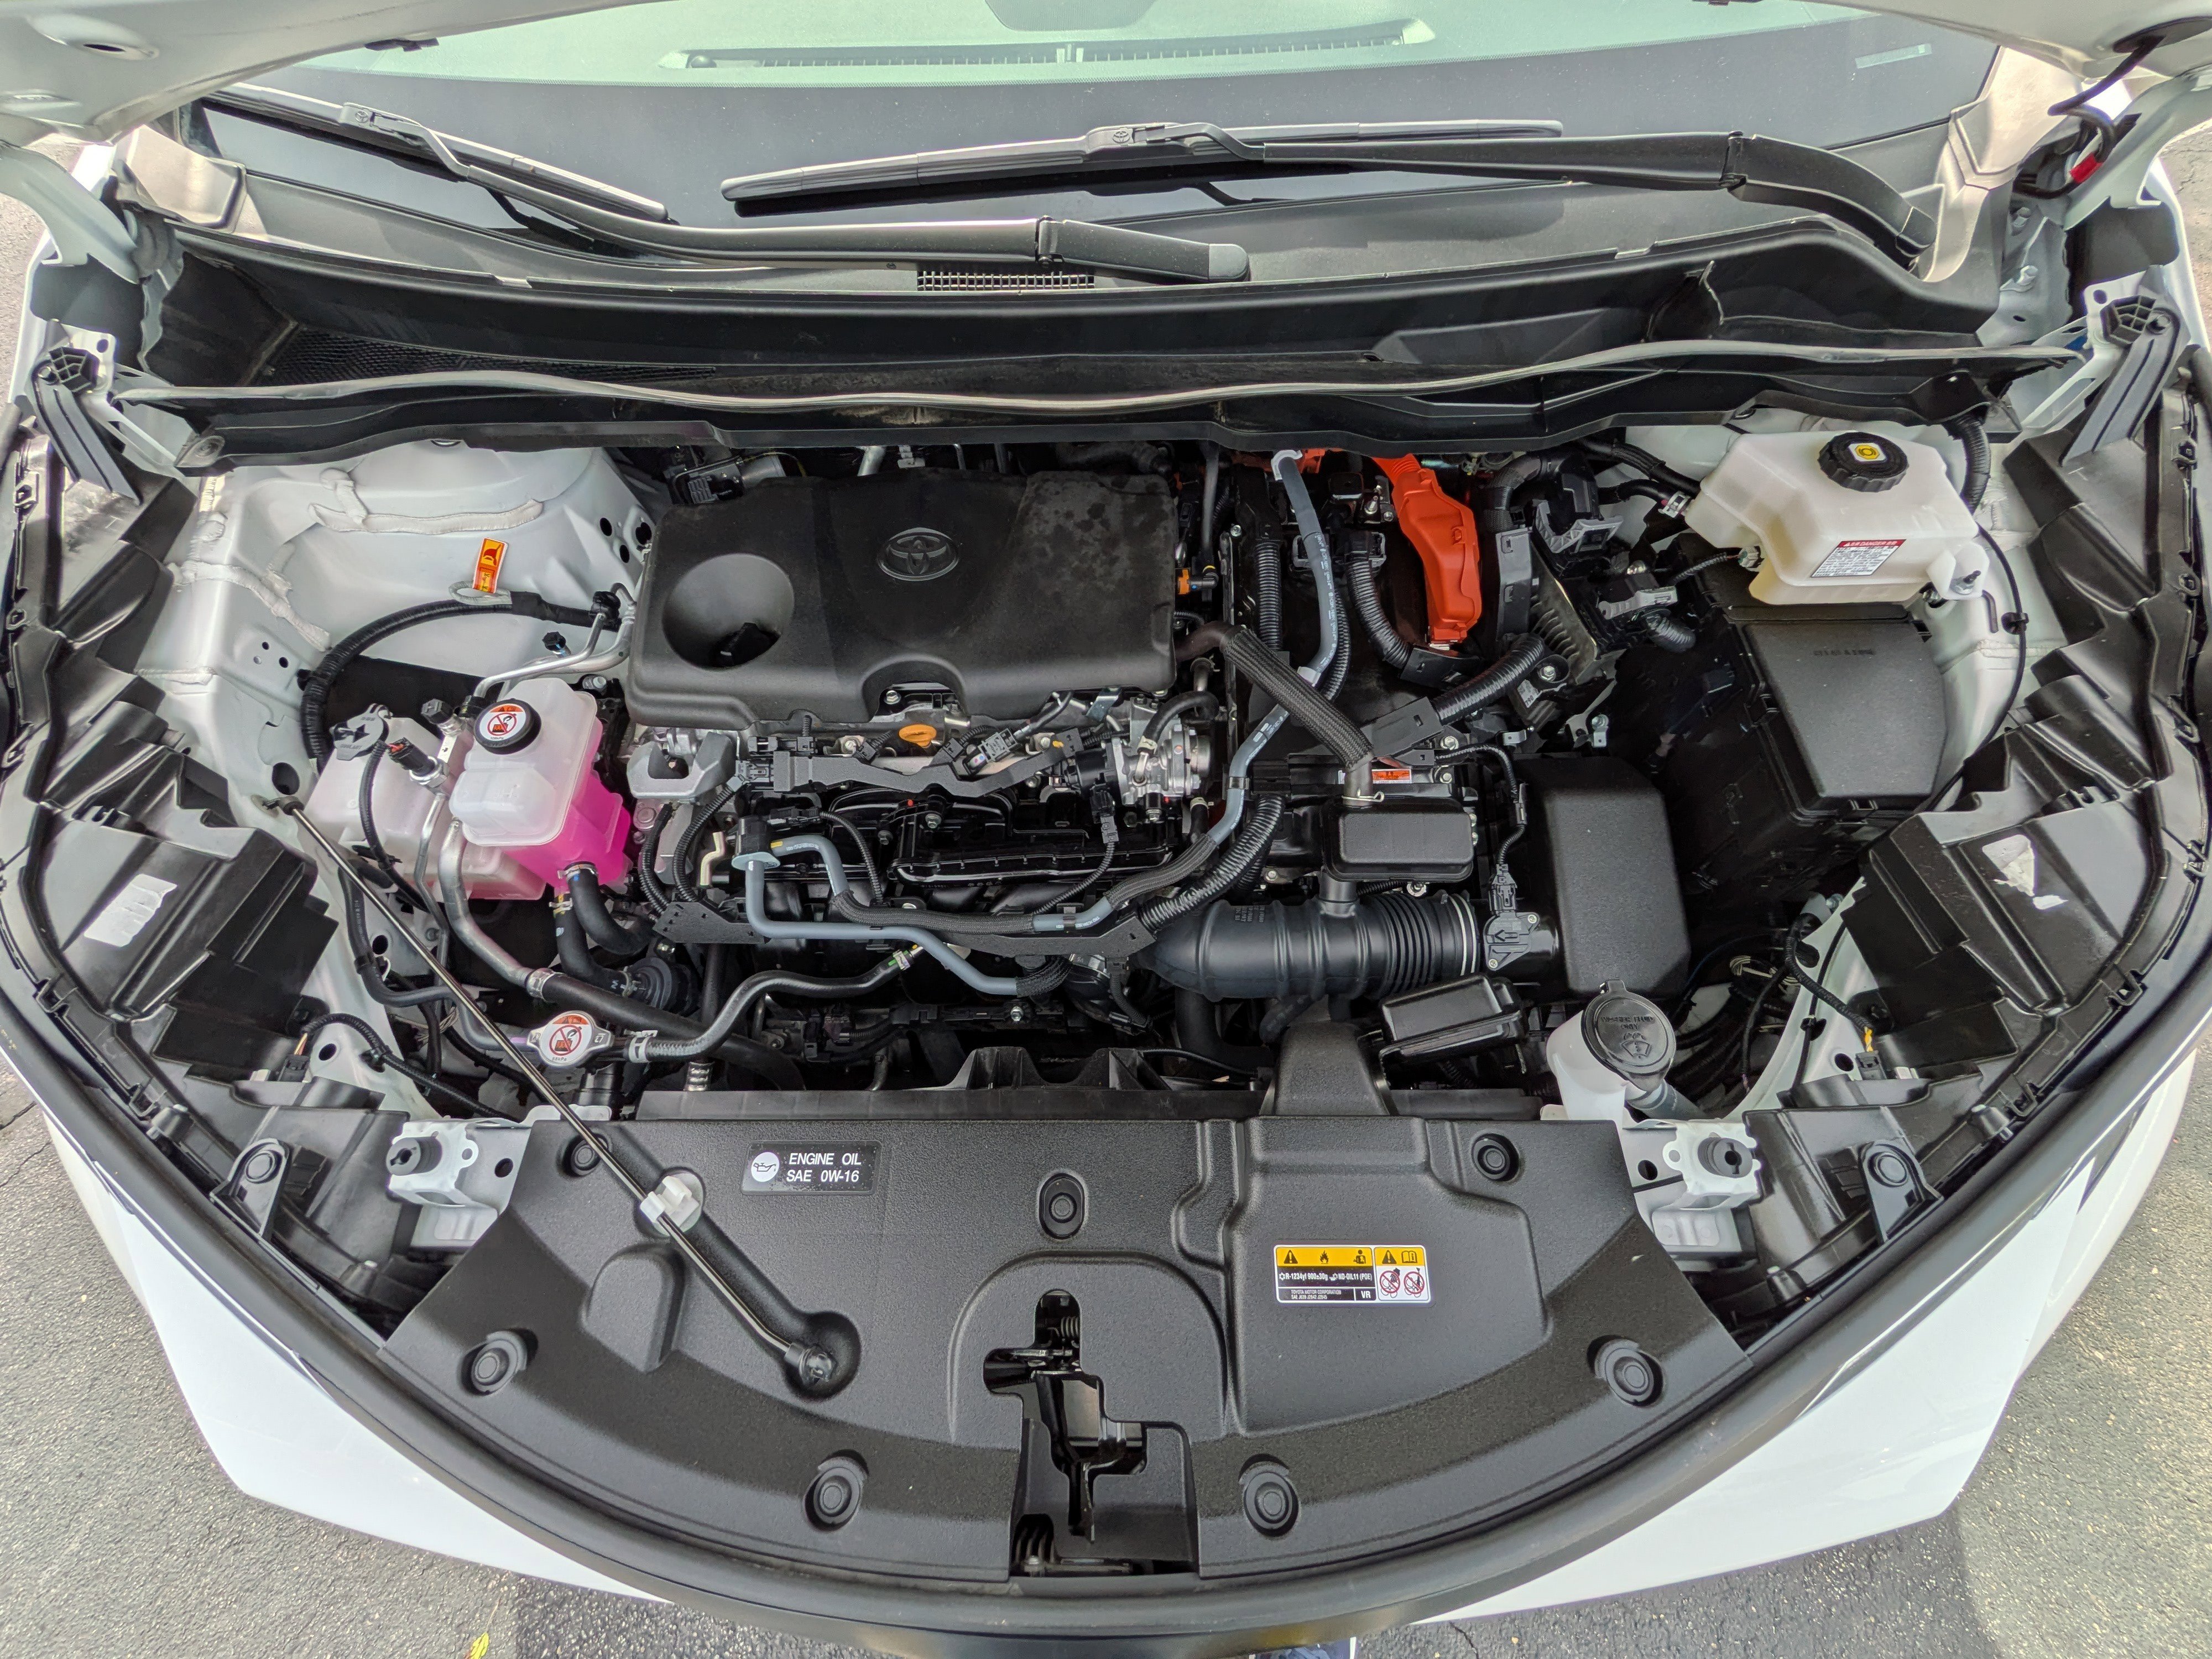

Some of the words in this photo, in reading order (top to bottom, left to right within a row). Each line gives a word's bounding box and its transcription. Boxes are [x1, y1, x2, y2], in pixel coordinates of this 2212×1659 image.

[789, 1152, 834, 1165] ENGINE
[842, 1152, 862, 1165] OIL
[786, 1170, 812, 1182] SAE
[820, 1170, 859, 1182] 0W-16
[1360, 1272, 1373, 1281] (POE)
[1360, 1290, 1371, 1298] VR
